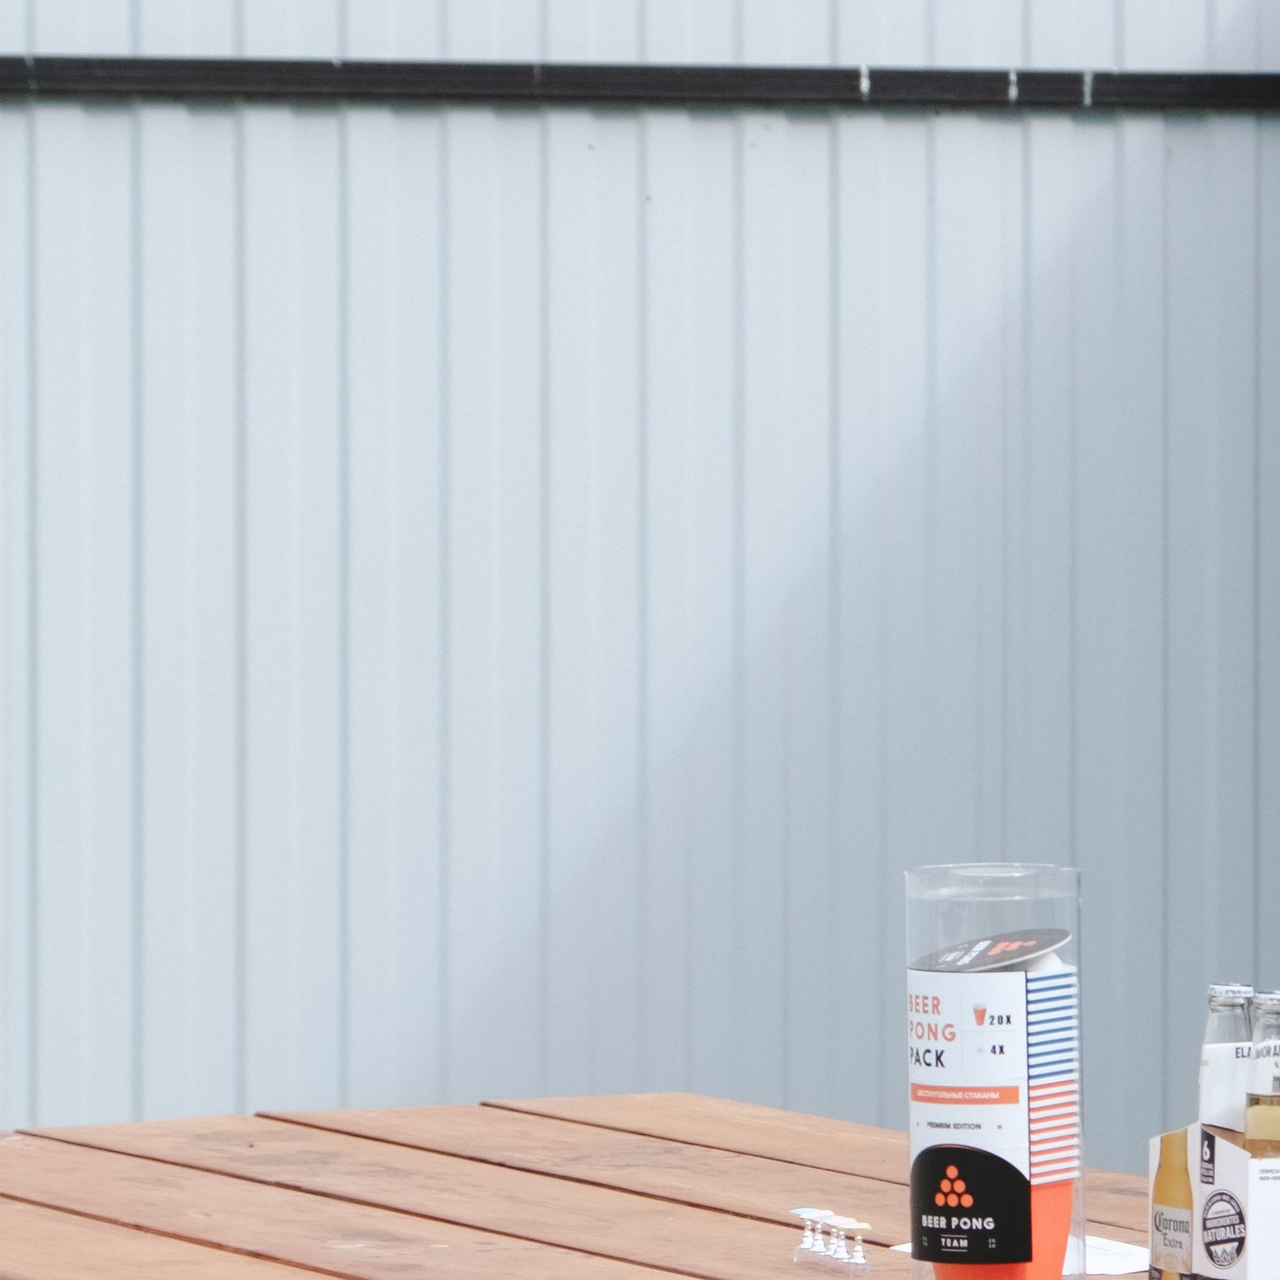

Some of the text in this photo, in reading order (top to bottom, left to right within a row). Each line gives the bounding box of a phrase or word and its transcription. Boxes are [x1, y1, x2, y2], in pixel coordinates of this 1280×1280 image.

[909, 1021, 956, 1042] PONG
[910, 1046, 945, 1068] PACK
[1202, 1140, 1211, 1161] 6
[922, 1215, 995, 1230] BEER PONG
[1154, 1210, 1190, 1234] Corona
[1161, 1232, 1184, 1250] Extra
[1203, 1224, 1246, 1241] NATURALES
[941, 1238, 968, 1248] TEAM
